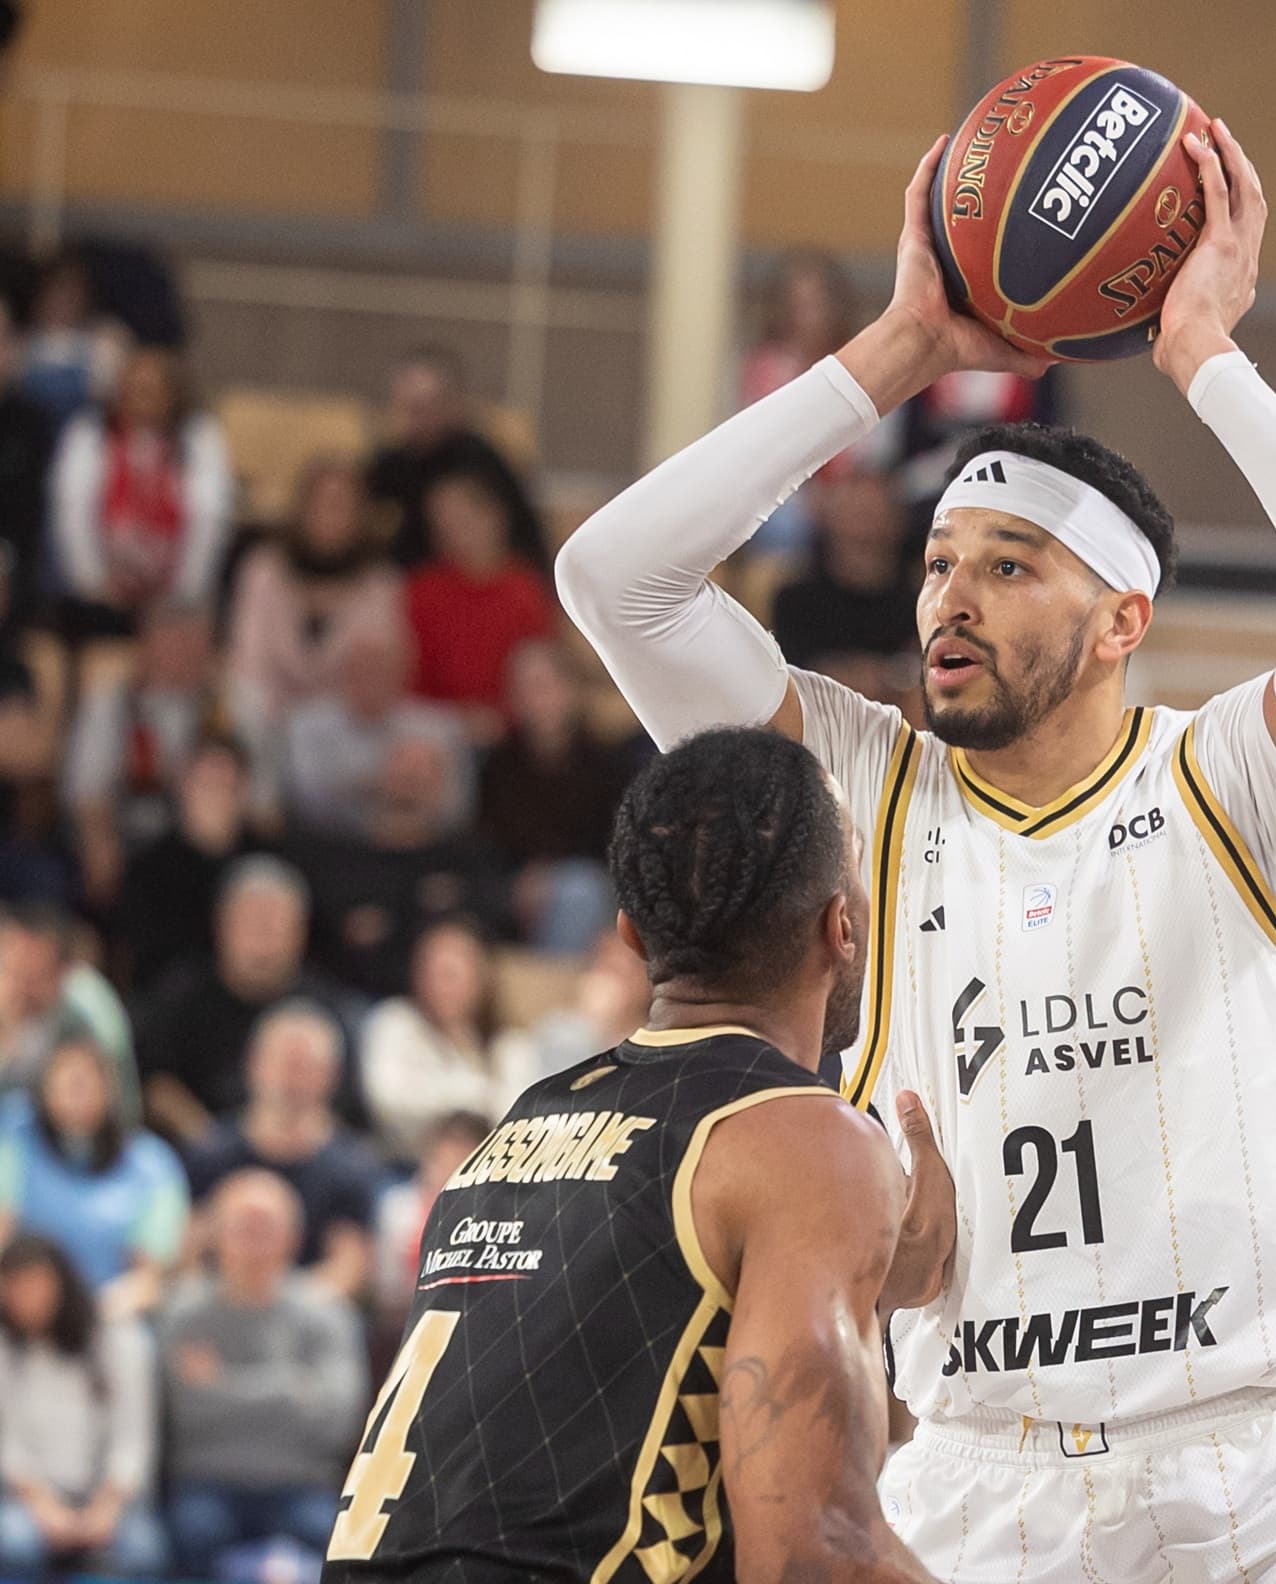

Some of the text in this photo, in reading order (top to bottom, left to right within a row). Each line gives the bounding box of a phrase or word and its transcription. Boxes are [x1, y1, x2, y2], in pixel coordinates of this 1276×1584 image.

[1043, 89, 1149, 222] Betclic
[1099, 188, 1205, 317] SPALD
[1108, 807, 1165, 850] DCB
[1020, 986, 1149, 1037] LDLC
[1024, 1036, 1154, 1075] ASVEL
[443, 1111, 657, 1191] LOSSOMGAME
[1003, 1119, 1104, 1253] 21
[450, 1216, 524, 1245] GROUPE
[473, 1244, 543, 1270] PASTOR
[326, 1310, 461, 1560] 4
